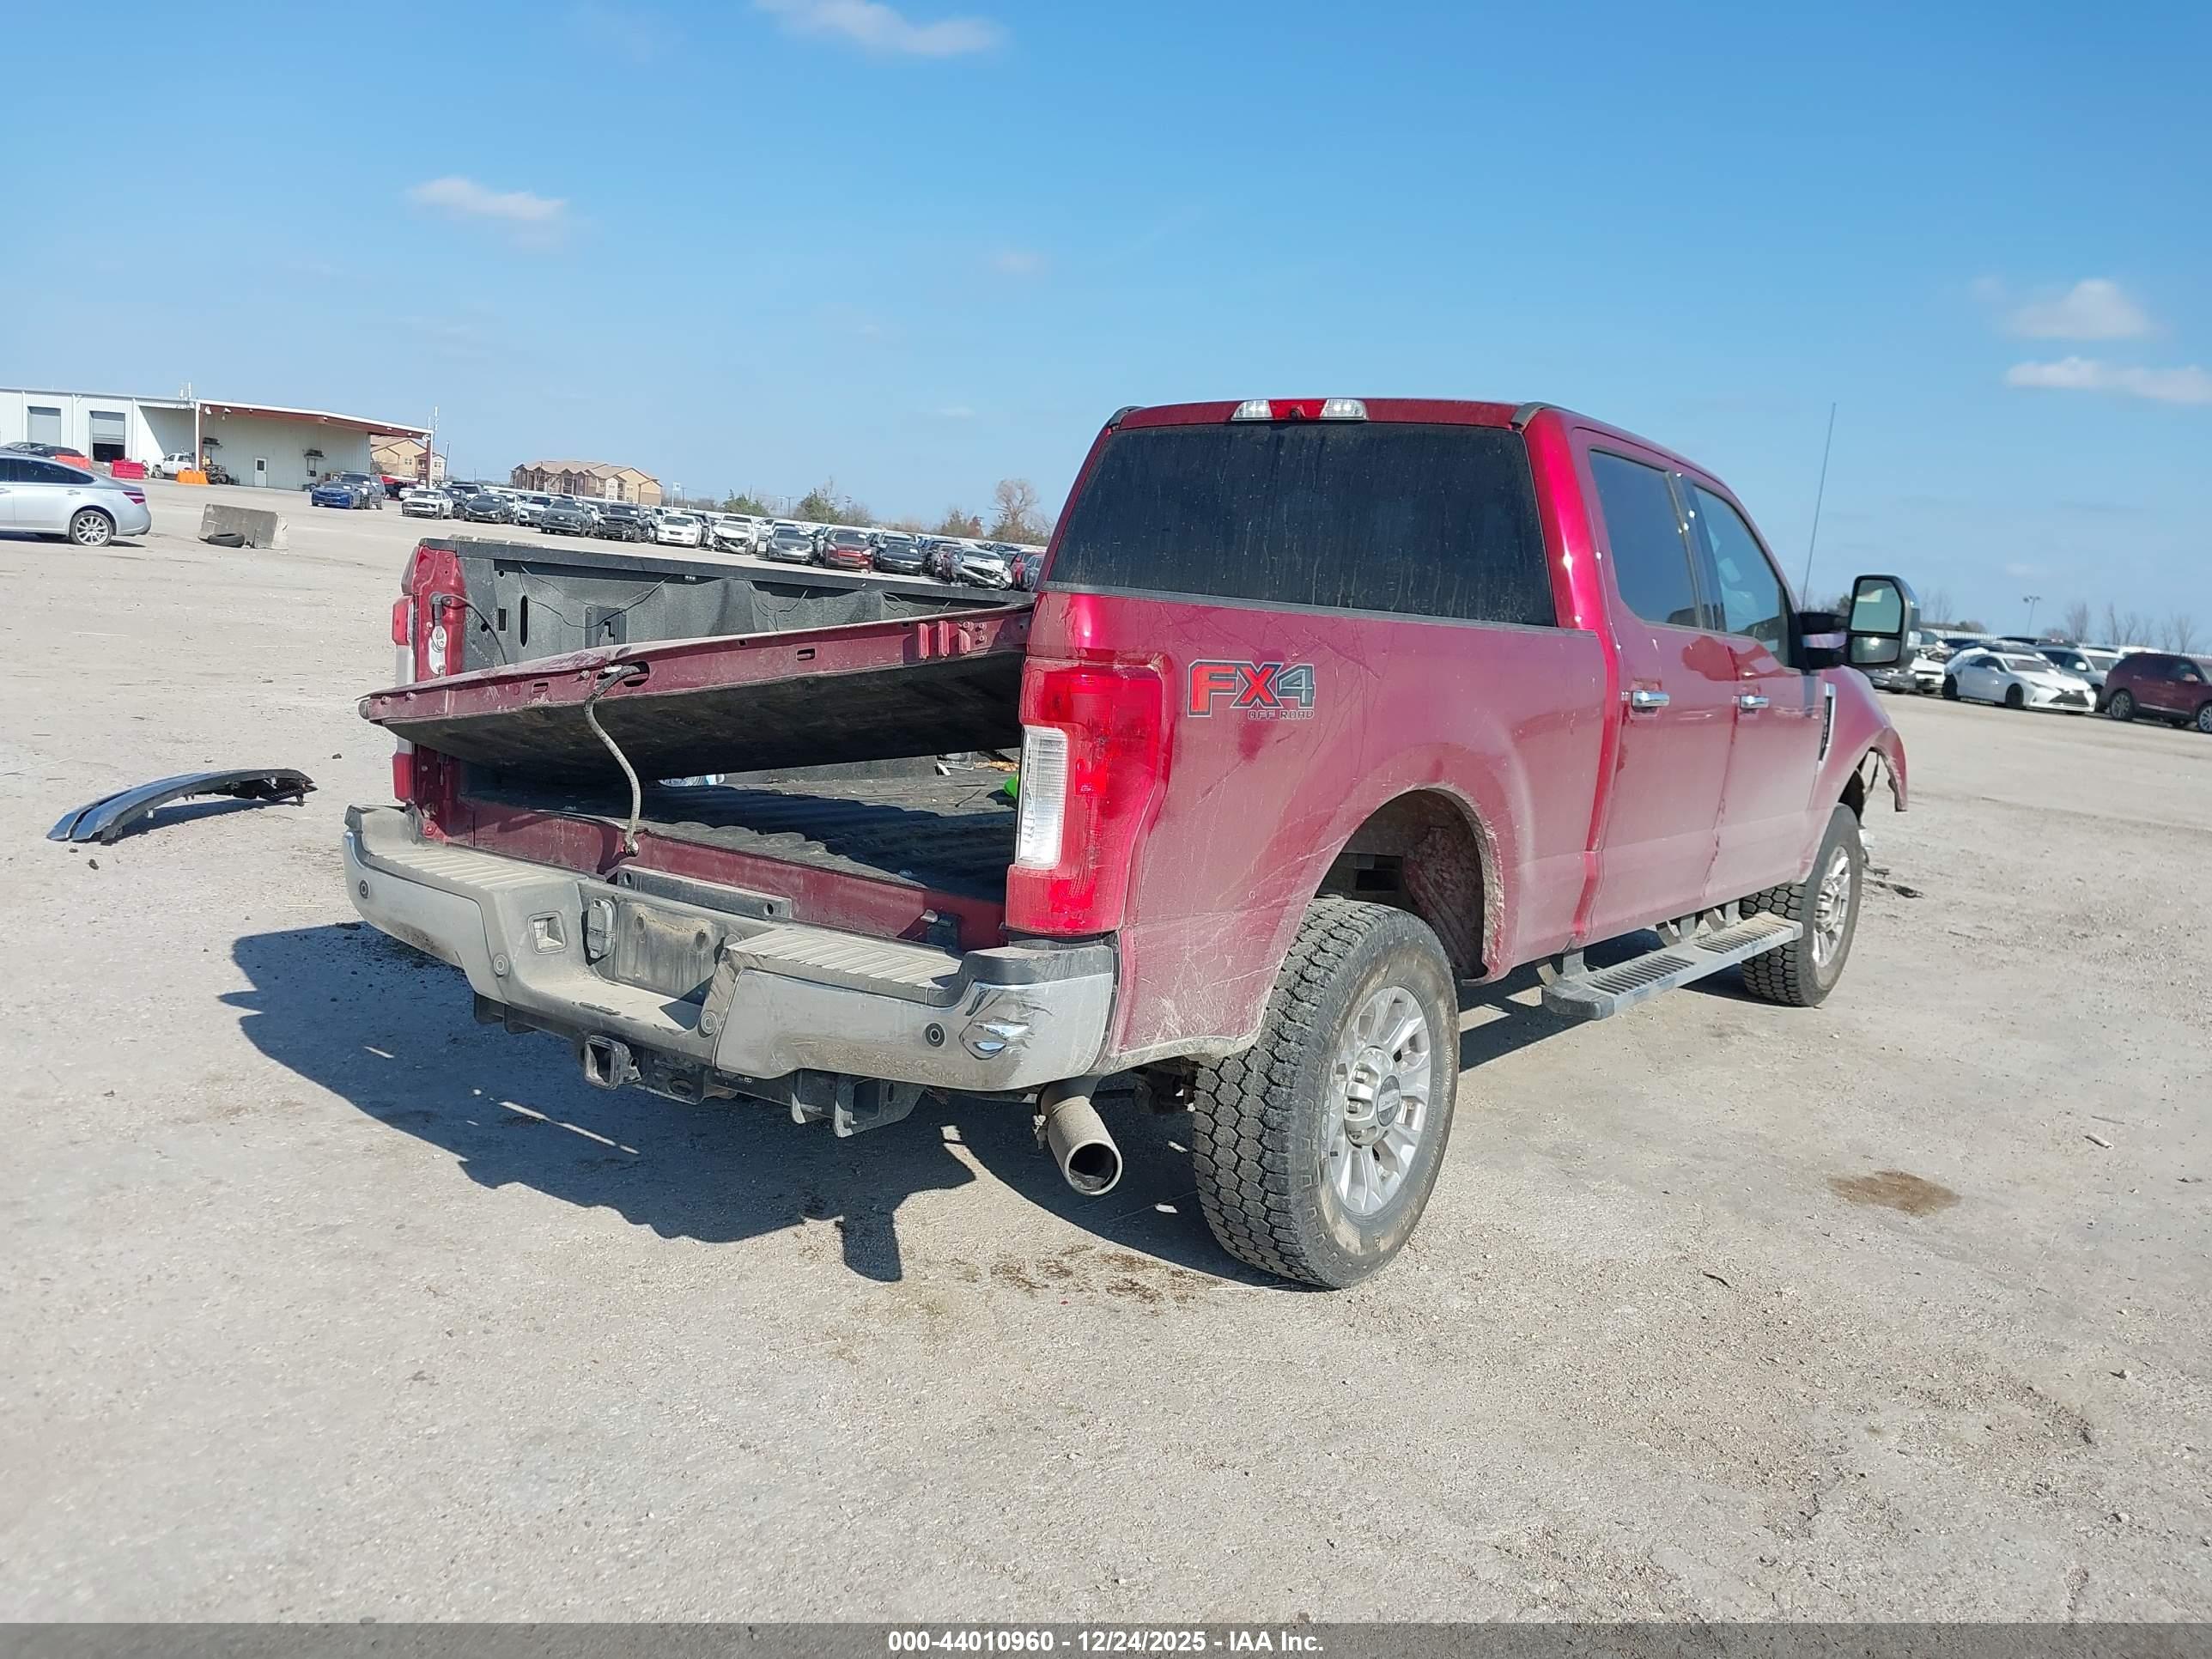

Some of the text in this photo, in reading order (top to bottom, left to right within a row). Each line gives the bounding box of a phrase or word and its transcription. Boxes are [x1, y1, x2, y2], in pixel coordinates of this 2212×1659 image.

[1188, 659, 1316, 717] FX4
[1248, 709, 1315, 720] OFF ROAD
